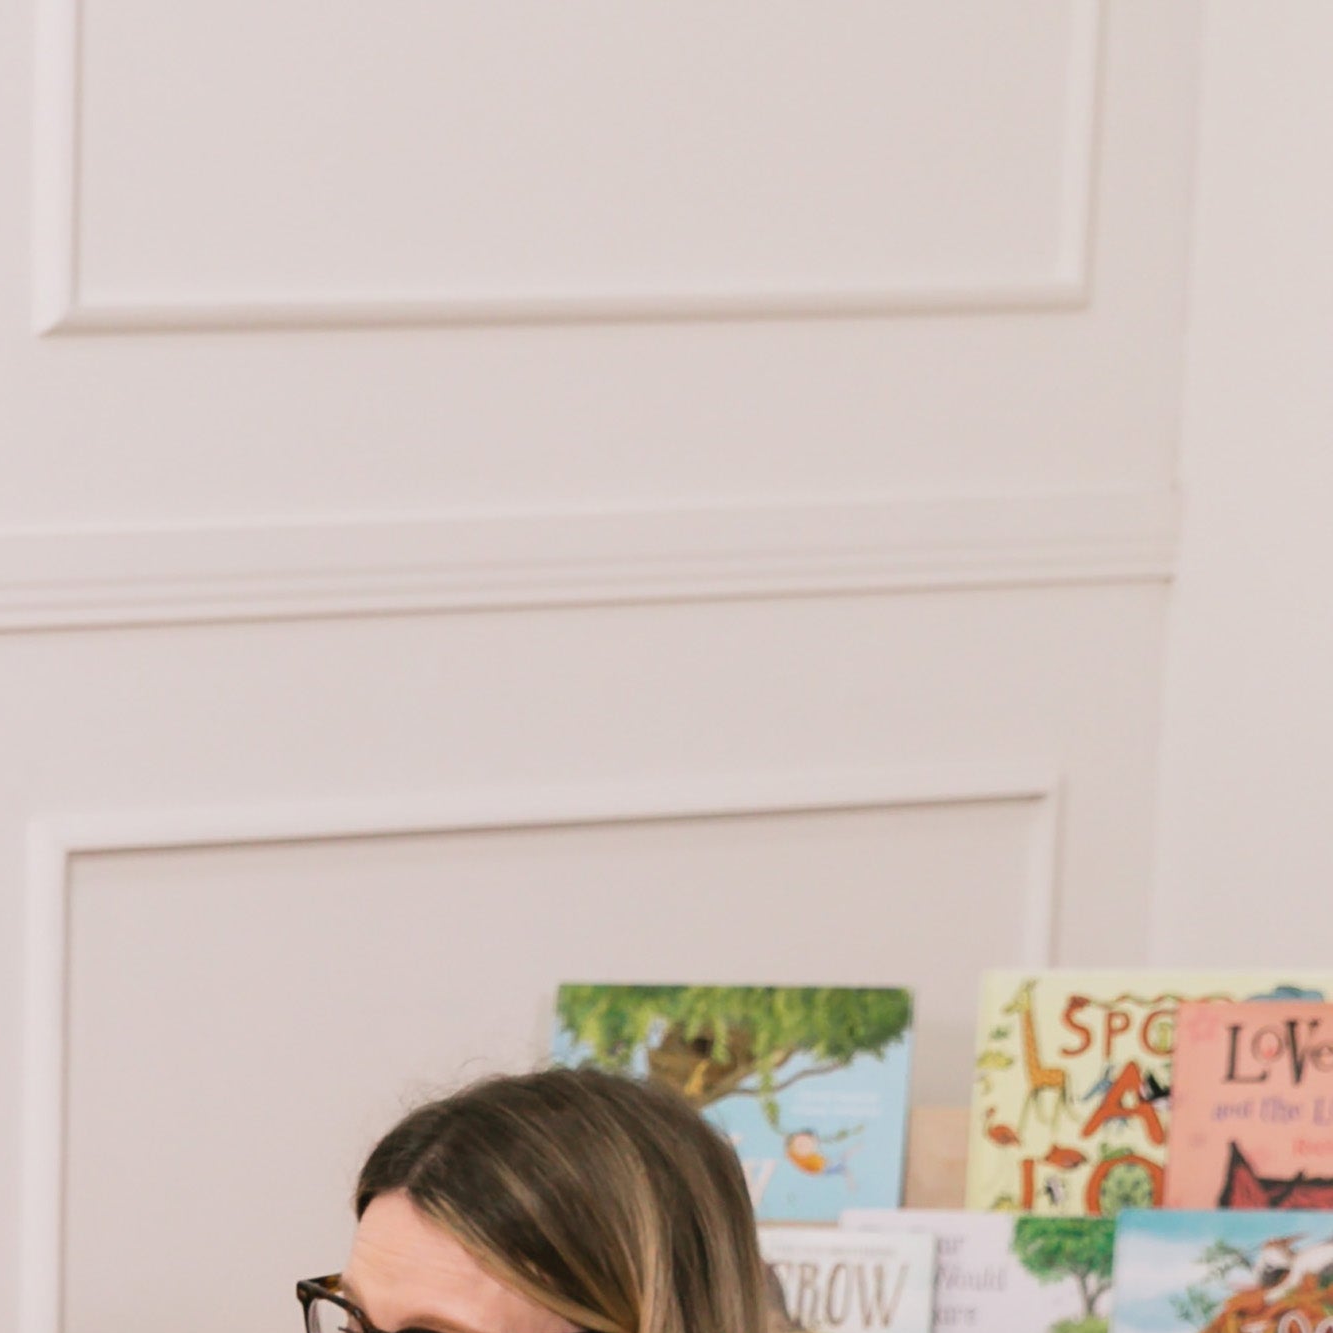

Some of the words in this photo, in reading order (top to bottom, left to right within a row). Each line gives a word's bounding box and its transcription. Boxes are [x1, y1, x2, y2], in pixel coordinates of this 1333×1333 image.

[1061, 997, 1173, 1058] SPO
[1081, 1060, 1165, 1146] A
[793, 1261, 910, 1331] ROW
